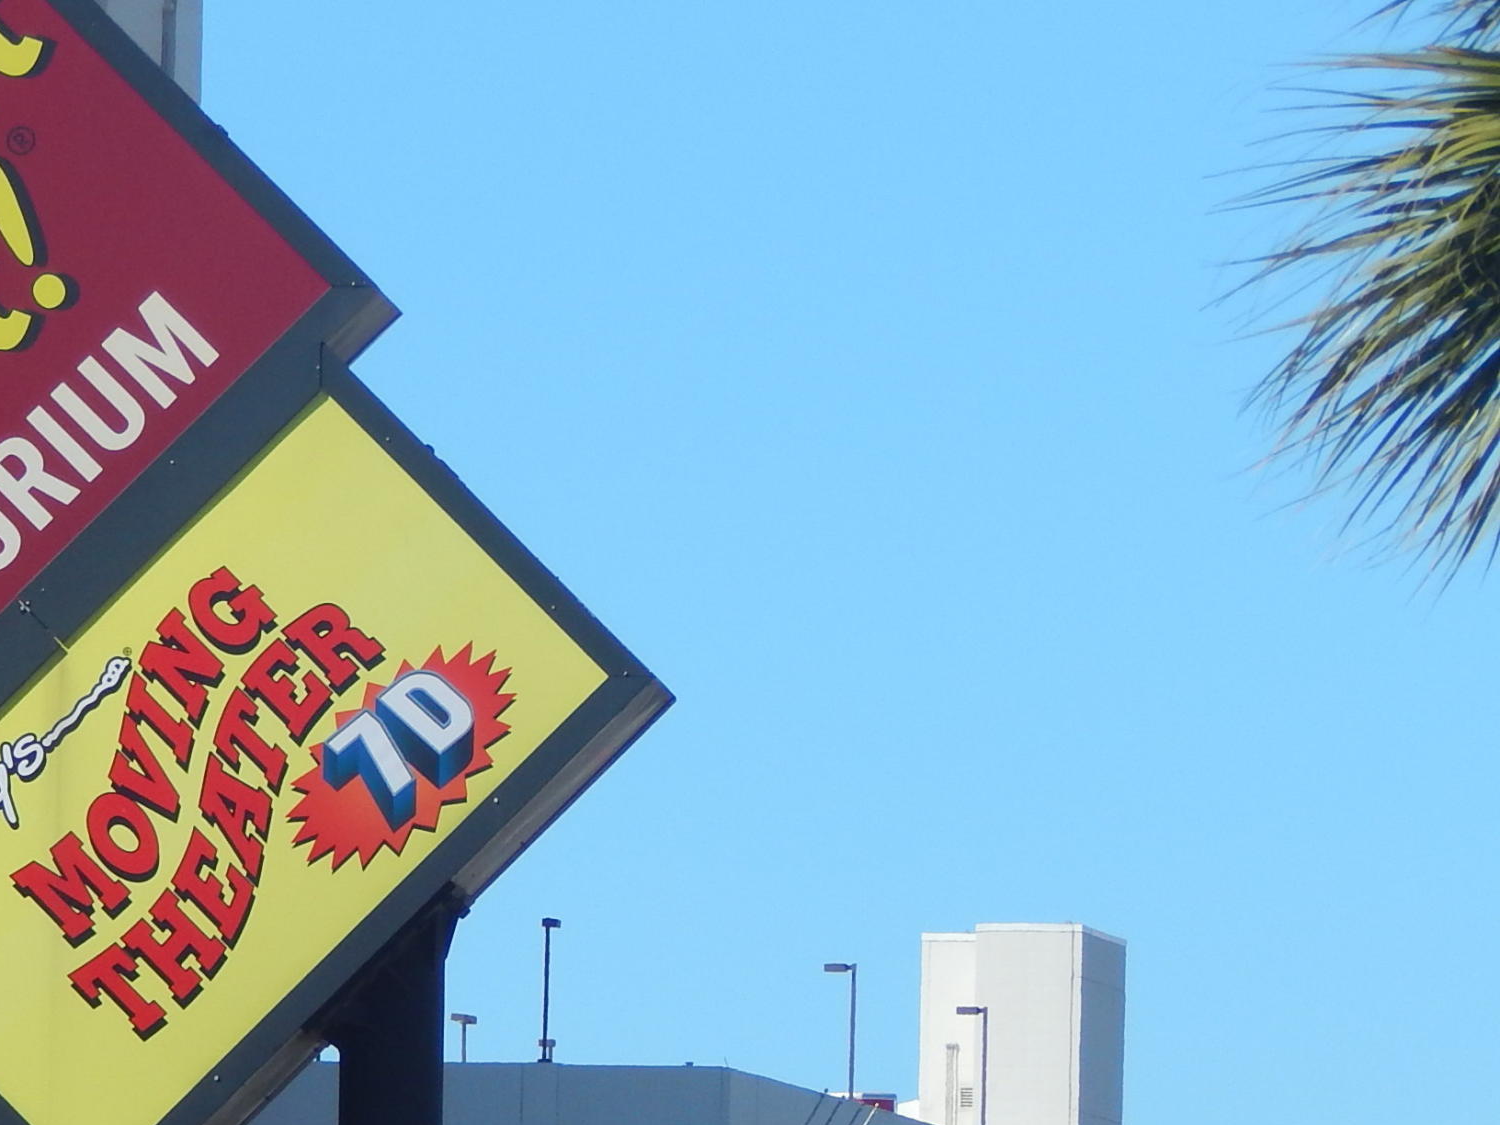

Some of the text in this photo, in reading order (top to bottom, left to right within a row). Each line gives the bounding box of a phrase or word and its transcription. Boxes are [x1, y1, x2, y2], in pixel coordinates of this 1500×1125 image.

[8, 564, 279, 949] MOVING
[66, 602, 387, 1042] THEATER
[322, 669, 477, 832] 7D
